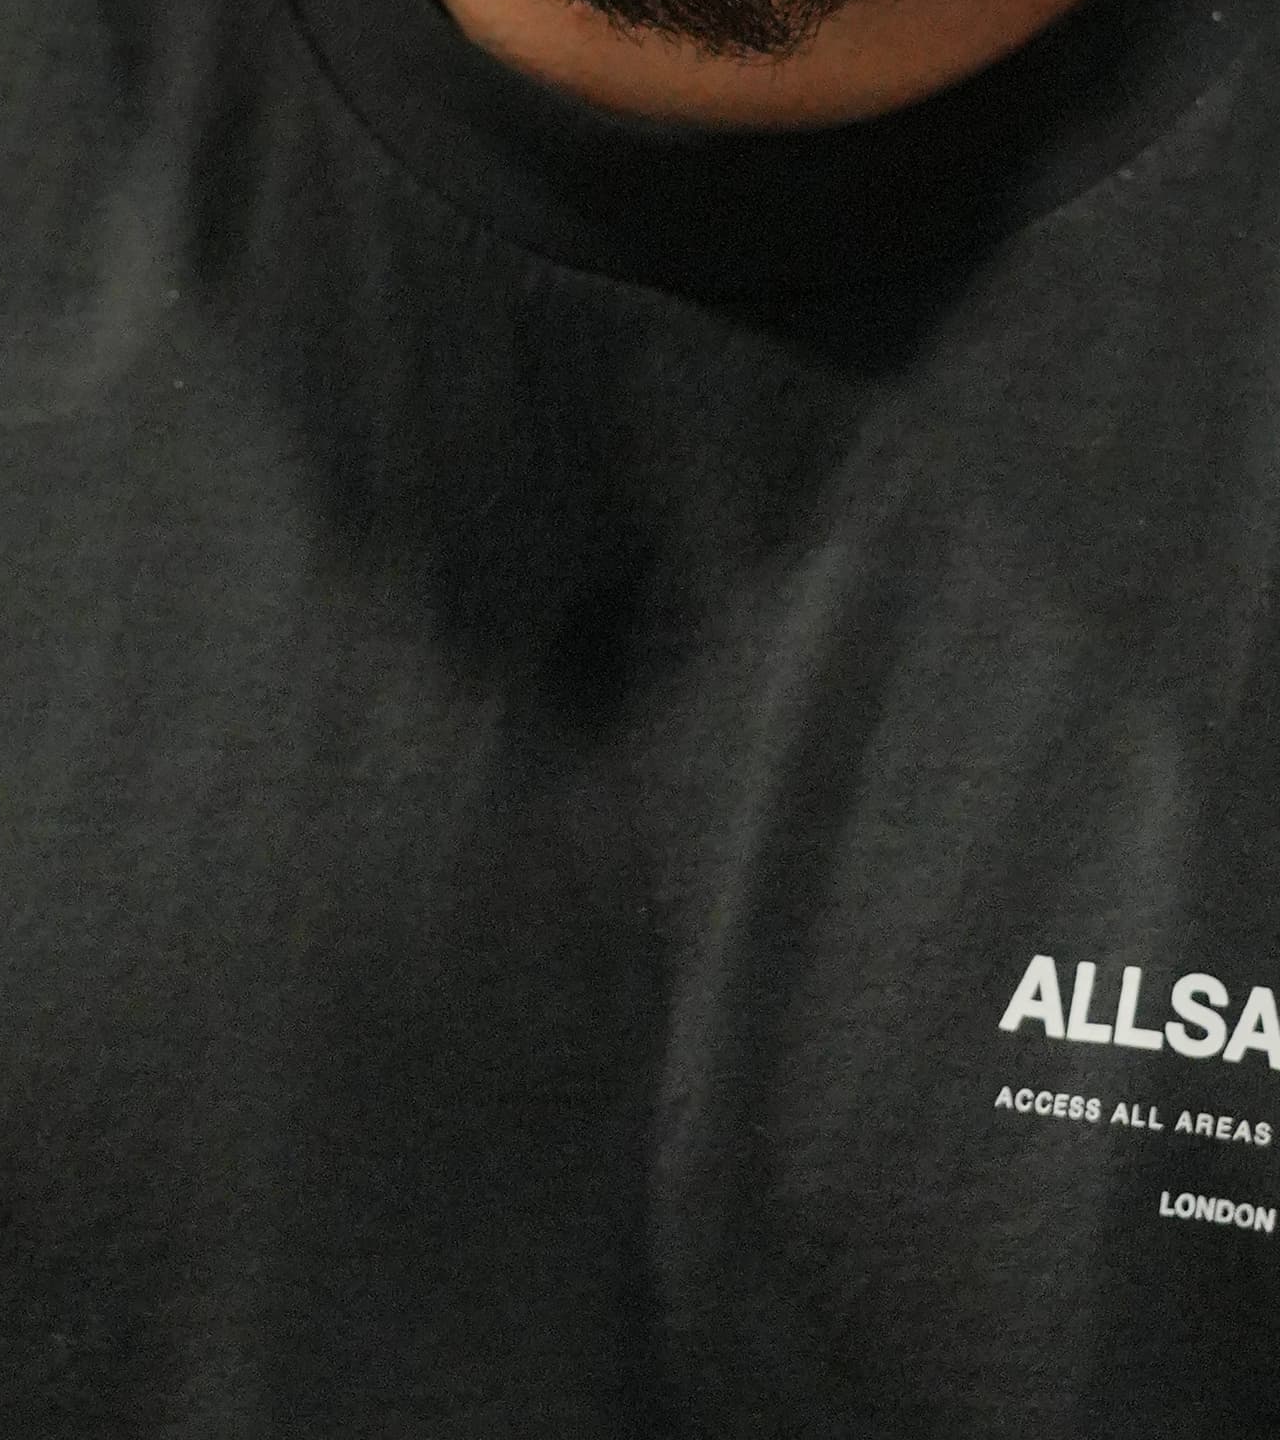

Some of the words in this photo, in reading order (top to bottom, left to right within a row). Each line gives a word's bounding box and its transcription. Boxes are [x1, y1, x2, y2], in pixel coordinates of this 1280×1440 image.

[994, 1085, 1102, 1123] ACCESS
[1109, 1102, 1164, 1131] ALL
[1174, 1110, 1273, 1146] AREAS
[1158, 1190, 1277, 1233] LONDON
